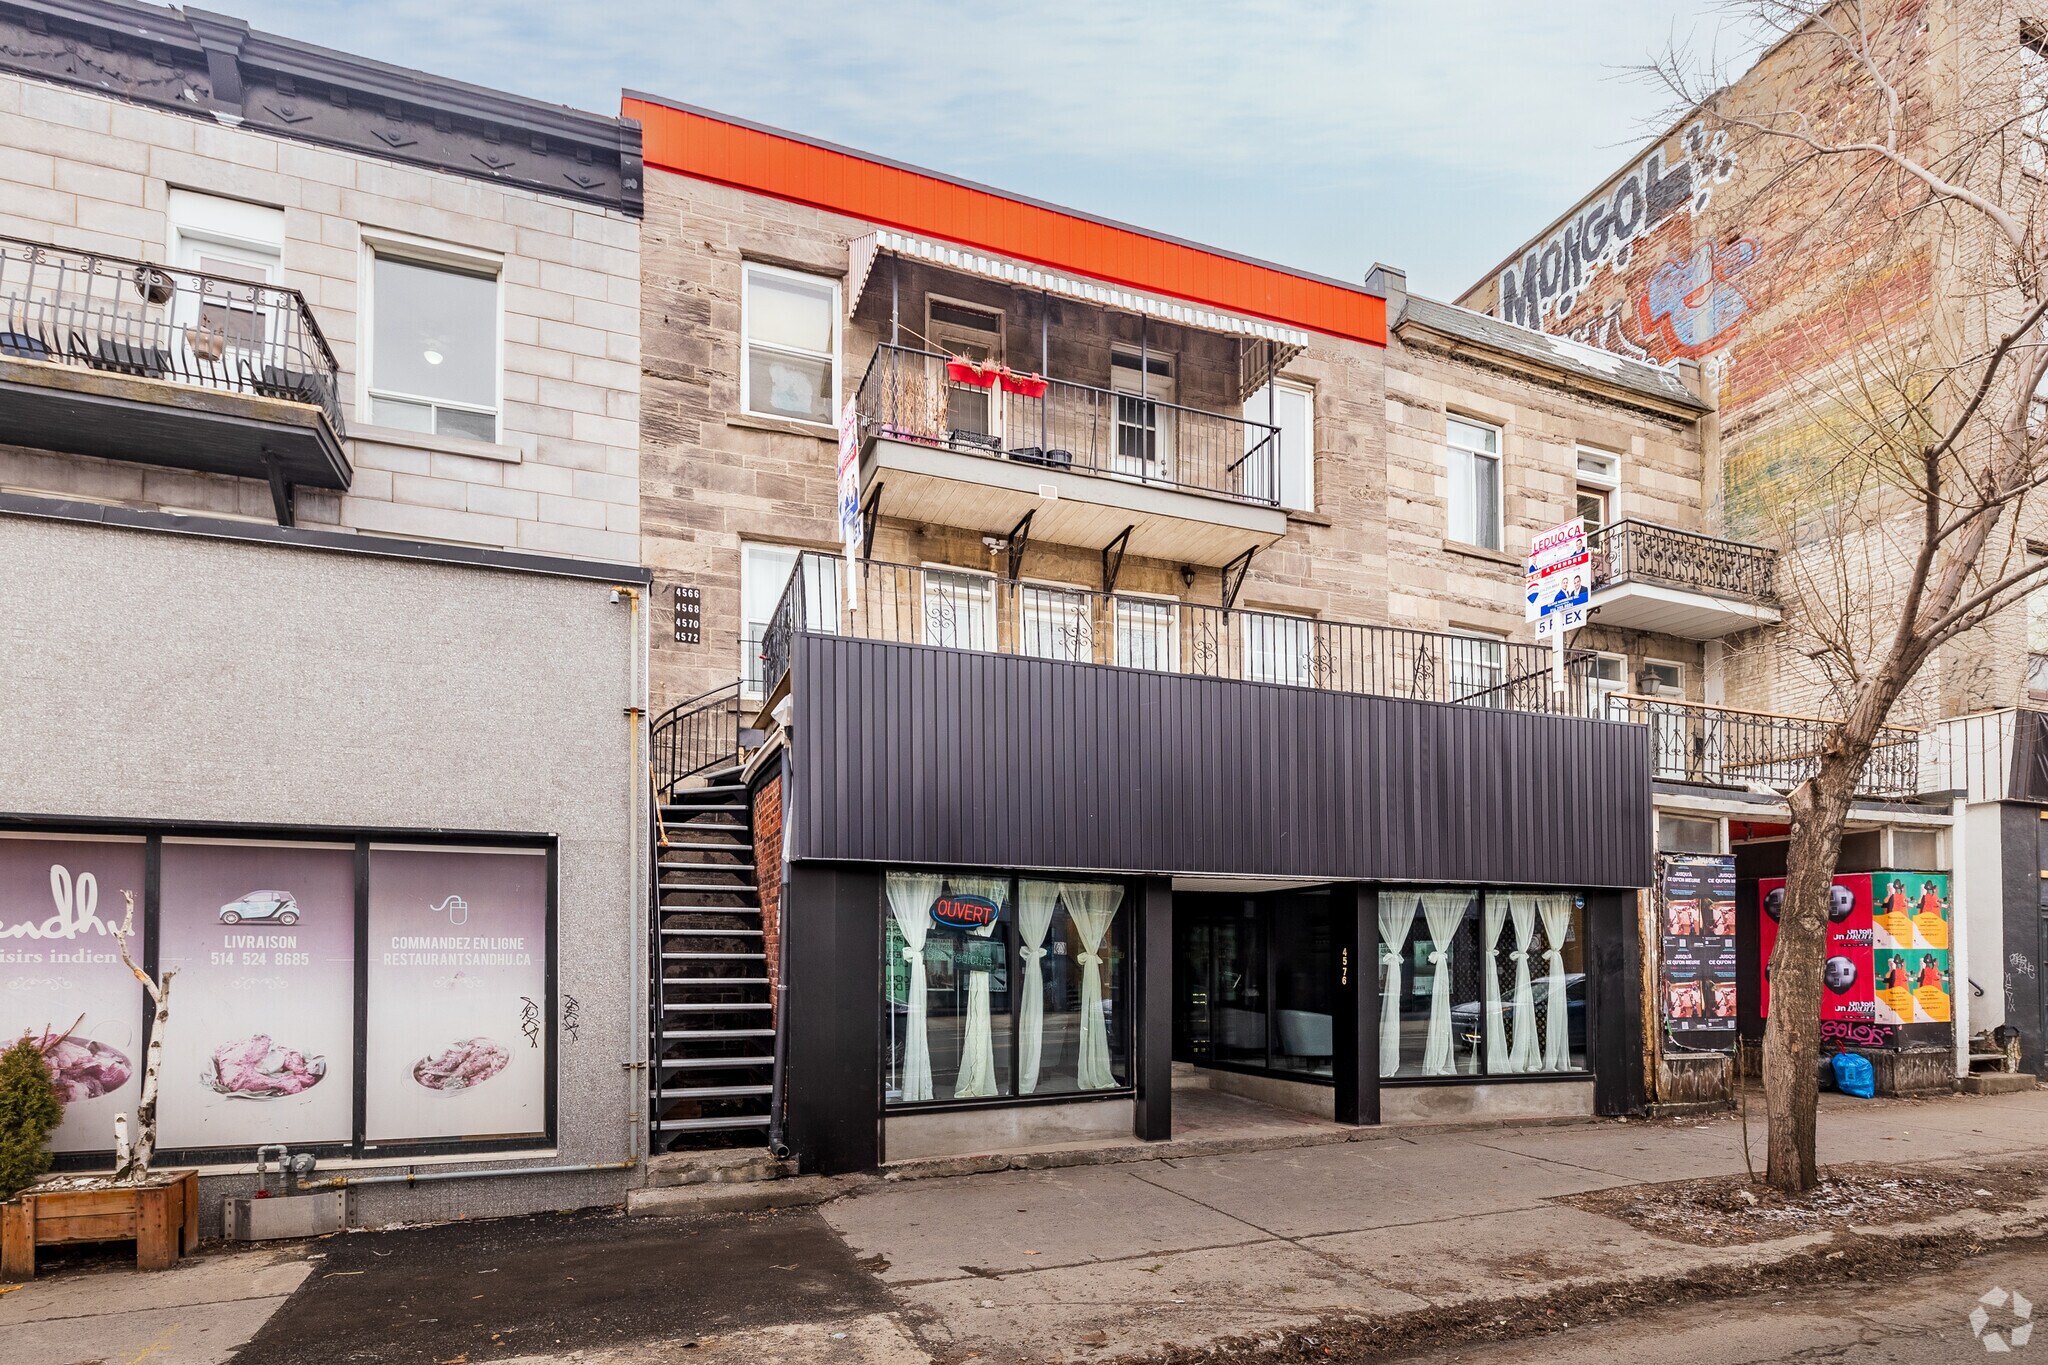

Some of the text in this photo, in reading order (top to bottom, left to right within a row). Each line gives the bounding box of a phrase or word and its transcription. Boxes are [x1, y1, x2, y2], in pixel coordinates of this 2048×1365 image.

[1534, 525, 1581, 552] LEDUO.CA
[1553, 556, 1582, 570] VENDRE
[676, 588, 699, 598] 4566
[676, 603, 699, 613] 4568
[676, 618, 699, 628] 4570
[1539, 622, 1546, 634] 5
[675, 632, 698, 642] 4572
[937, 899, 992, 924] OUVERT
[224, 935, 297, 949] LIVRAISON
[391, 936, 525, 950] COMMANDEZ EN LIGNE
[210, 952, 310, 966] 514 524 8685
[383, 952, 531, 966] RESTAURANTSANDHU.CA
